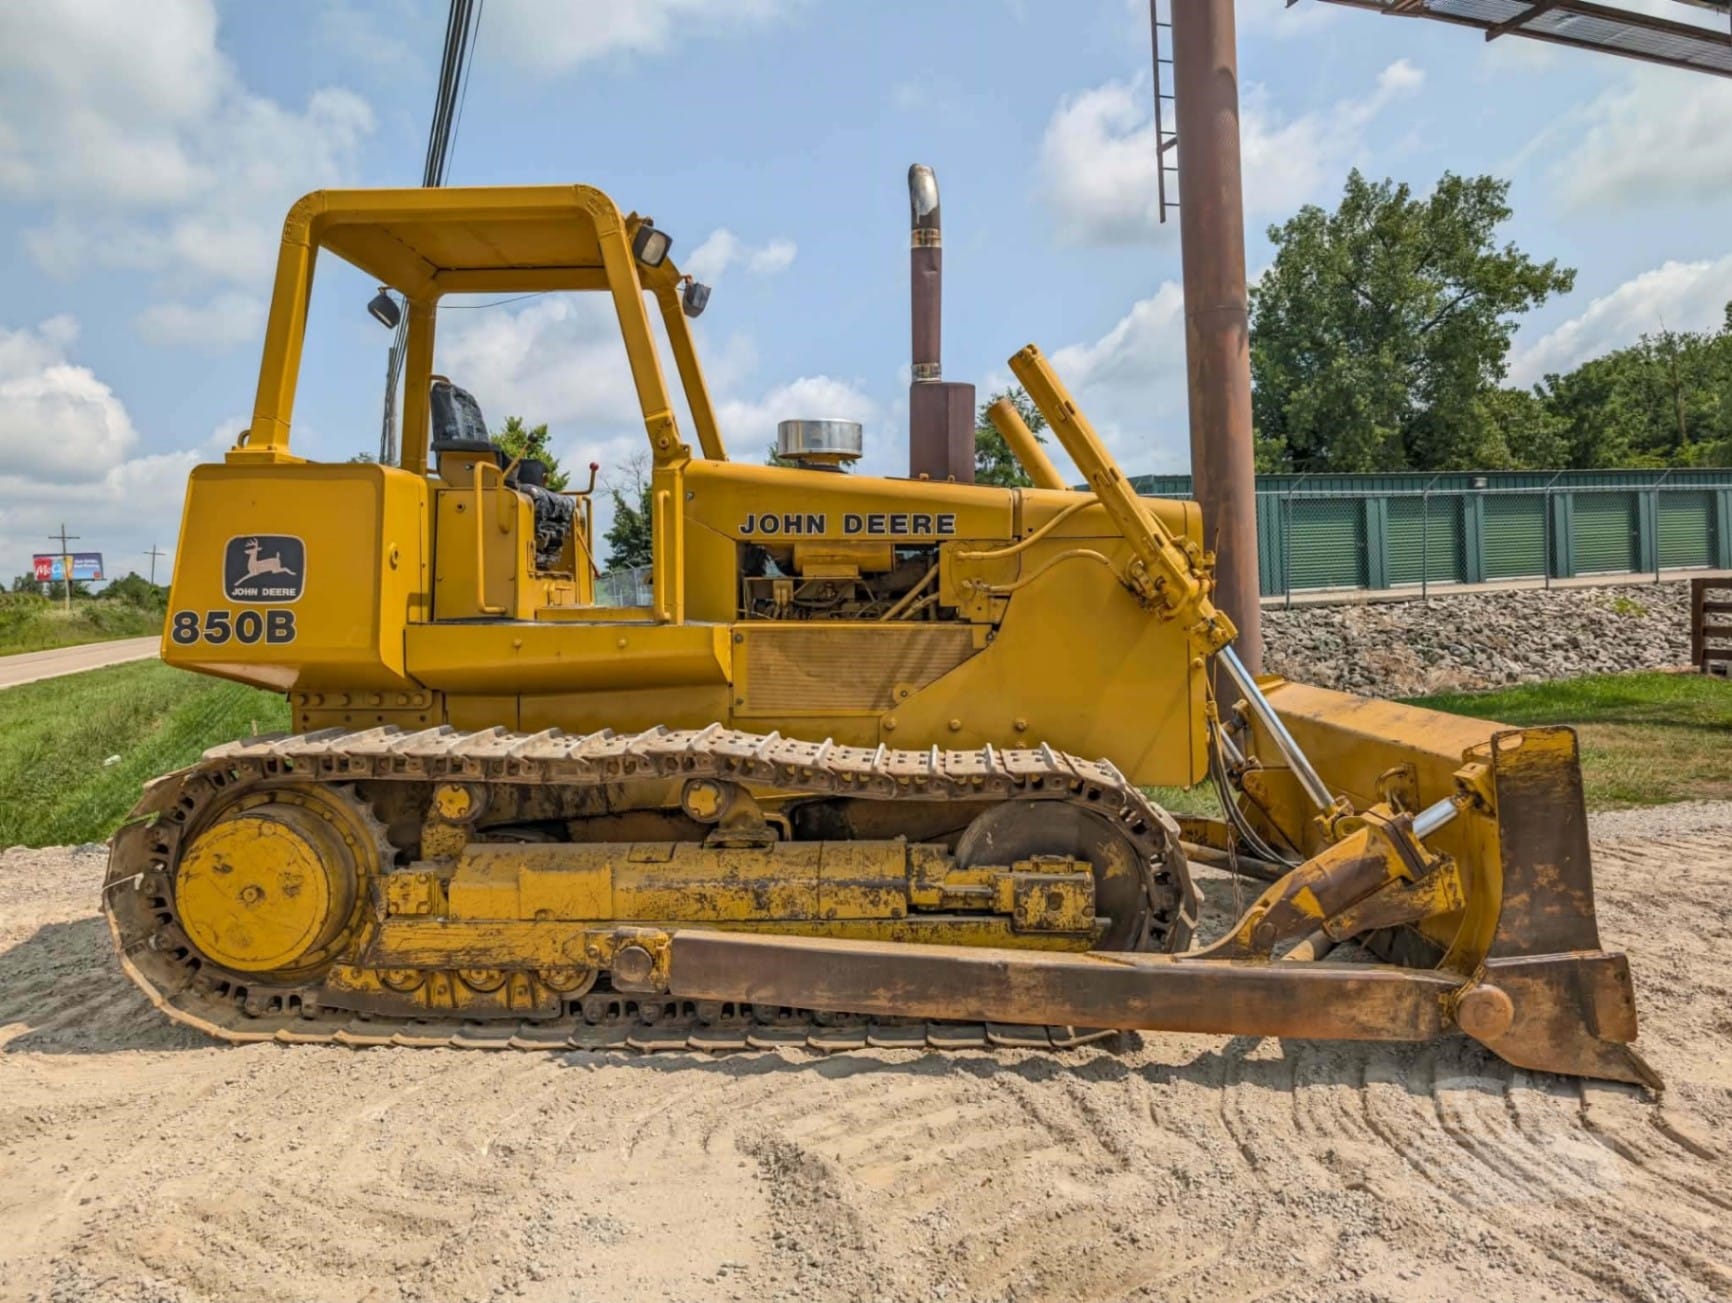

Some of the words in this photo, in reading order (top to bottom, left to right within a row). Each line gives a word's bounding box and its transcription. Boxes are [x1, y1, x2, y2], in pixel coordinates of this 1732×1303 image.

[739, 513, 826, 535] JOHN
[842, 513, 956, 535] DEERE
[231, 587, 258, 596] JOHN
[262, 587, 296, 596] DEERE
[171, 609, 297, 645] 850B
